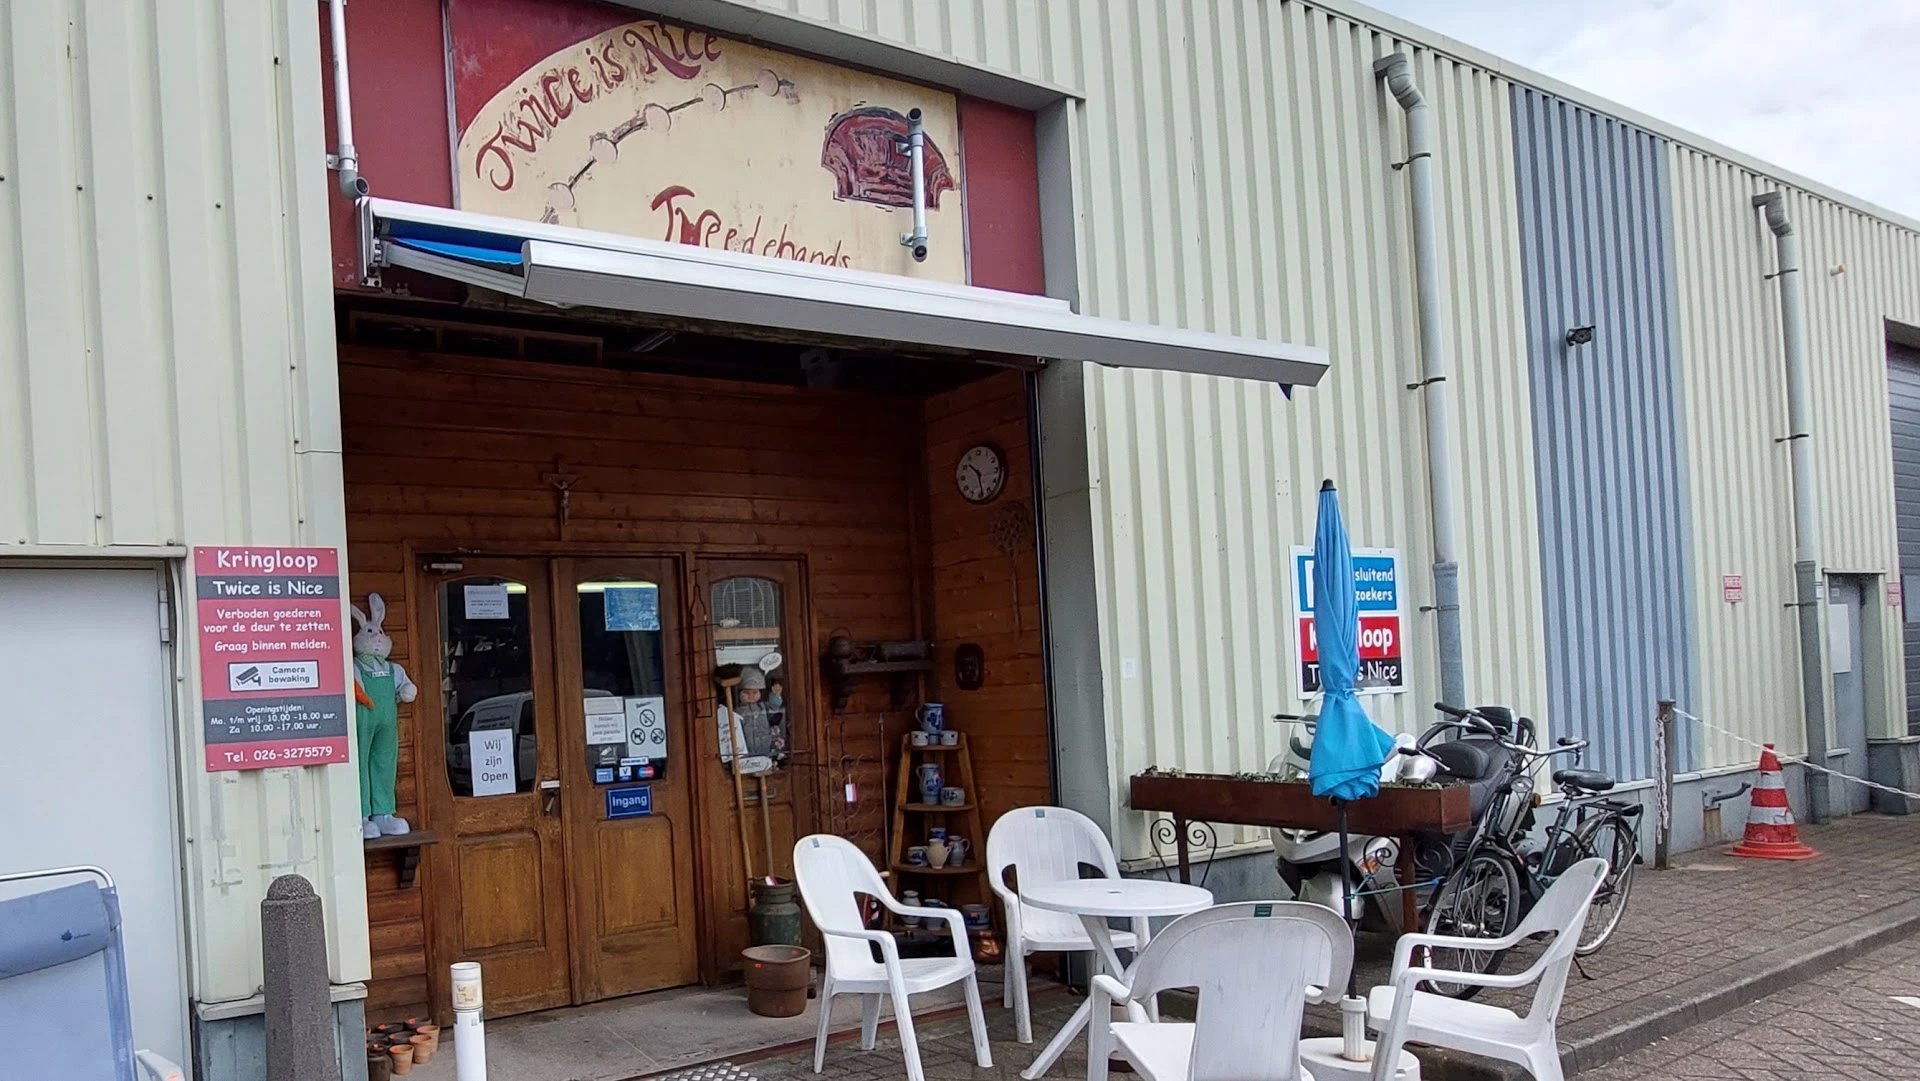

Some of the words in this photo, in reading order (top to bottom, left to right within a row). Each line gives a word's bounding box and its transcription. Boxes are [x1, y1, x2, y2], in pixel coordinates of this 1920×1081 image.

[476, 67, 594, 192] Twice
[590, 40, 627, 90] is
[624, 22, 723, 81] Nice
[217, 550, 318, 573] Kringloop
[1354, 567, 1394, 582] sluitend
[213, 580, 261, 595] Twice
[268, 580, 281, 595] is
[287, 580, 324, 595] Nice
[1355, 586, 1393, 601] zoekers
[216, 609, 270, 620] Verboden
[273, 609, 322, 622] goederen
[203, 624, 228, 633] voor
[232, 622, 246, 633] de
[250, 622, 276, 633] deur
[279, 622, 292, 632] te
[295, 621, 334, 632] zetten.
[214, 641, 248, 654] Graag
[252, 640, 287, 651] binnen
[290, 639, 331, 650] melden.
[272, 666, 306, 674] Camera
[1367, 660, 1398, 681] Nice
[268, 675, 310, 684] bewaking
[229, 725, 241, 734] Za
[484, 739, 502, 751] Wij
[224, 752, 248, 764] Tel.
[253, 745, 333, 762] 026-3275579
[485, 756, 503, 767] zijn
[481, 772, 509, 783] Open
[612, 795, 648, 808] Ingang
